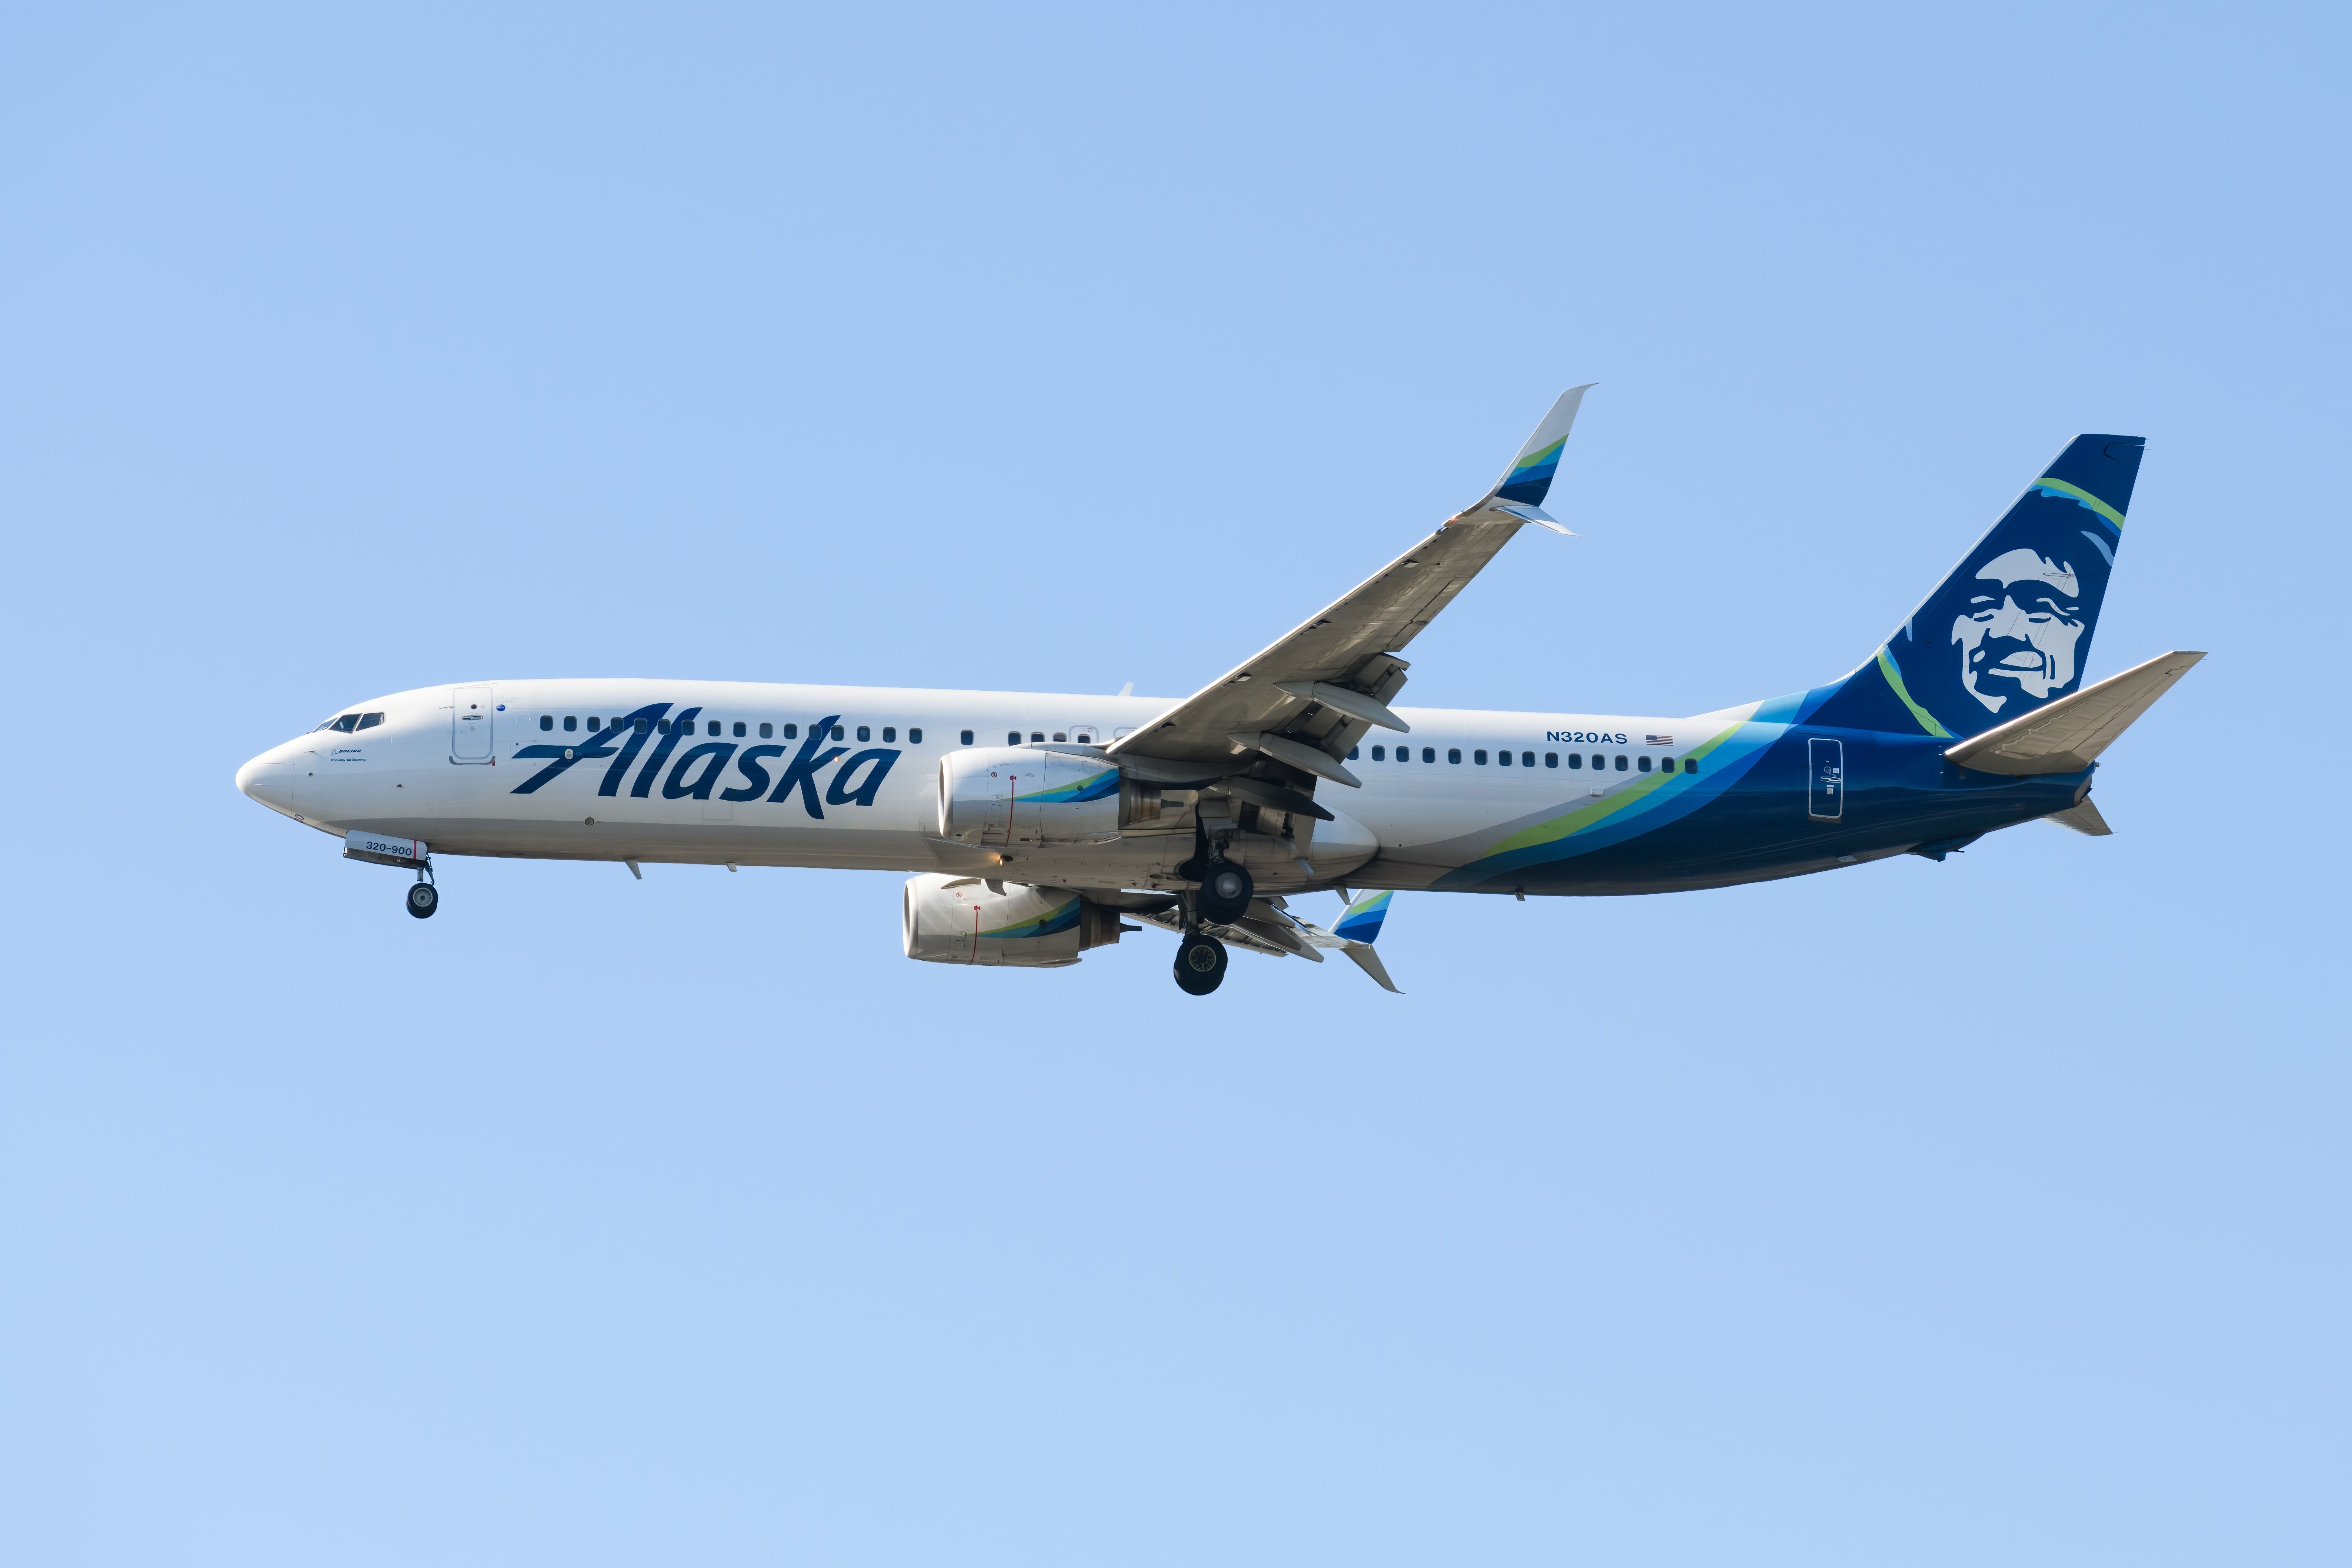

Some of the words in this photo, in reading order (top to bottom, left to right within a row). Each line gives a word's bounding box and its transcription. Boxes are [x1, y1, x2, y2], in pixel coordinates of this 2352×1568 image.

[1547, 731, 1628, 744] N320AS
[509, 703, 903, 820] Alaska
[366, 841, 412, 856] 320-900
